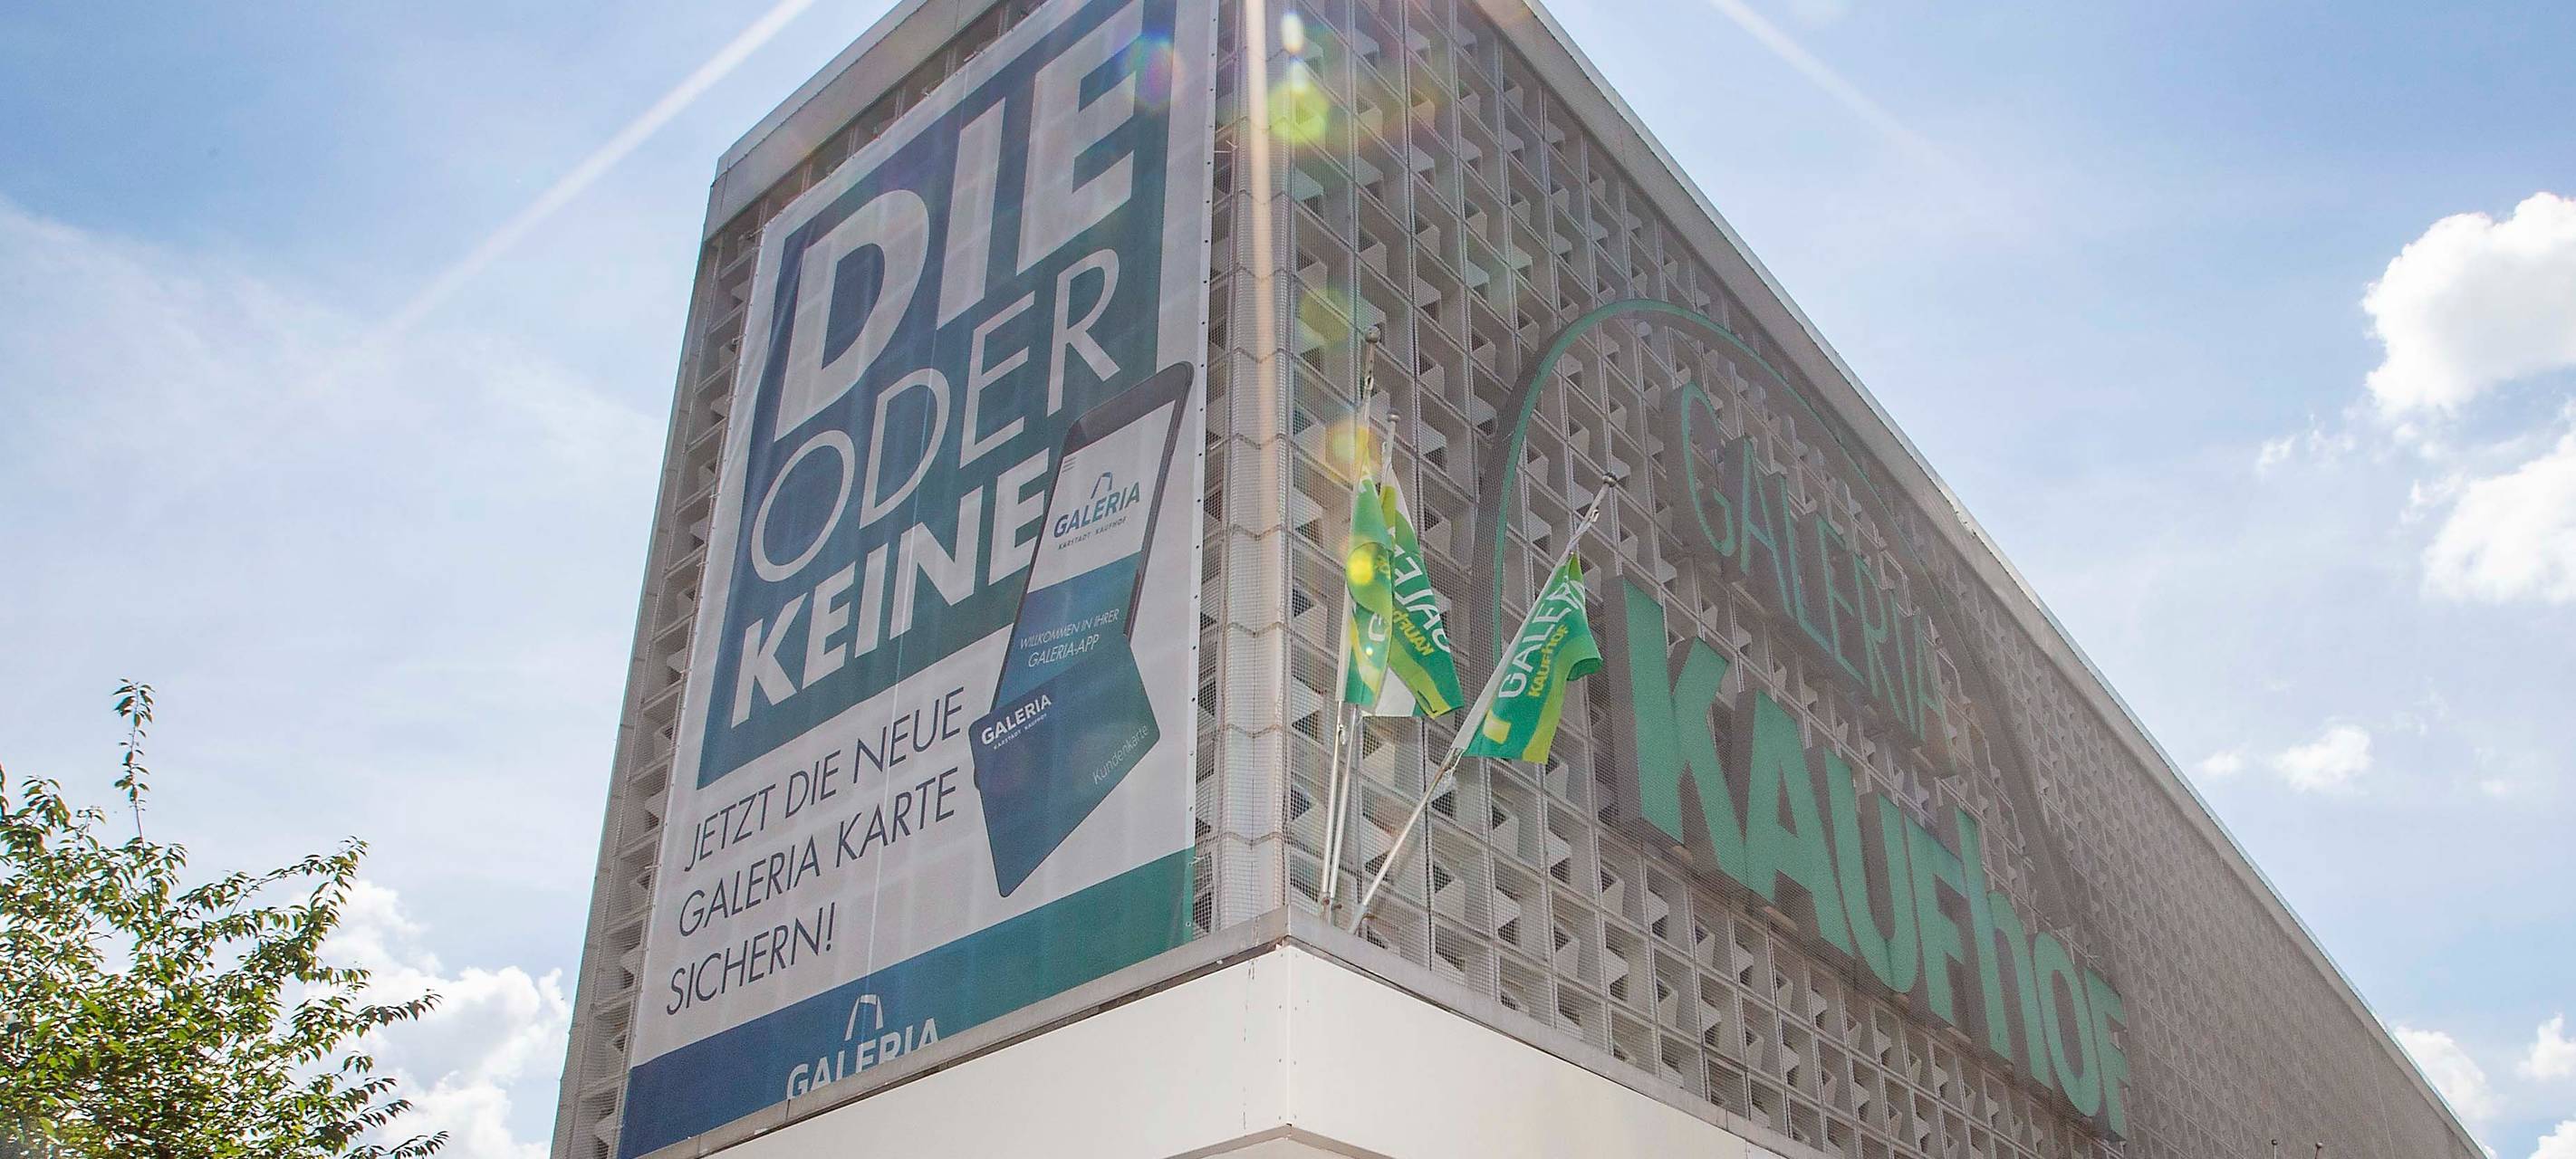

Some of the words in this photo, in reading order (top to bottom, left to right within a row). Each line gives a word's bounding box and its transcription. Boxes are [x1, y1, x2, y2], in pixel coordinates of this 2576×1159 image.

[774, 0, 1144, 443] DIE
[751, 248, 1121, 583] ODER
[1053, 481, 1140, 539] GALERIA
[1681, 381, 1956, 771] GALERIA
[731, 447, 1050, 730] KEINE
[1020, 621, 1080, 650] WILLKOMMEN
[1081, 617, 1093, 631] IN
[1093, 608, 1120, 627] IHRER
[1028, 633, 1100, 668] GALERIA-APP
[684, 784, 775, 872] JETZT
[784, 751, 841, 820] DIE
[852, 686, 966, 785] NEUE
[981, 694, 1052, 745] GALERIA
[1092, 725, 1149, 785] Kundenkarte
[678, 835, 822, 938] GALERIA
[834, 766, 960, 869] KARTE
[666, 901, 836, 1016] SICHERN!
